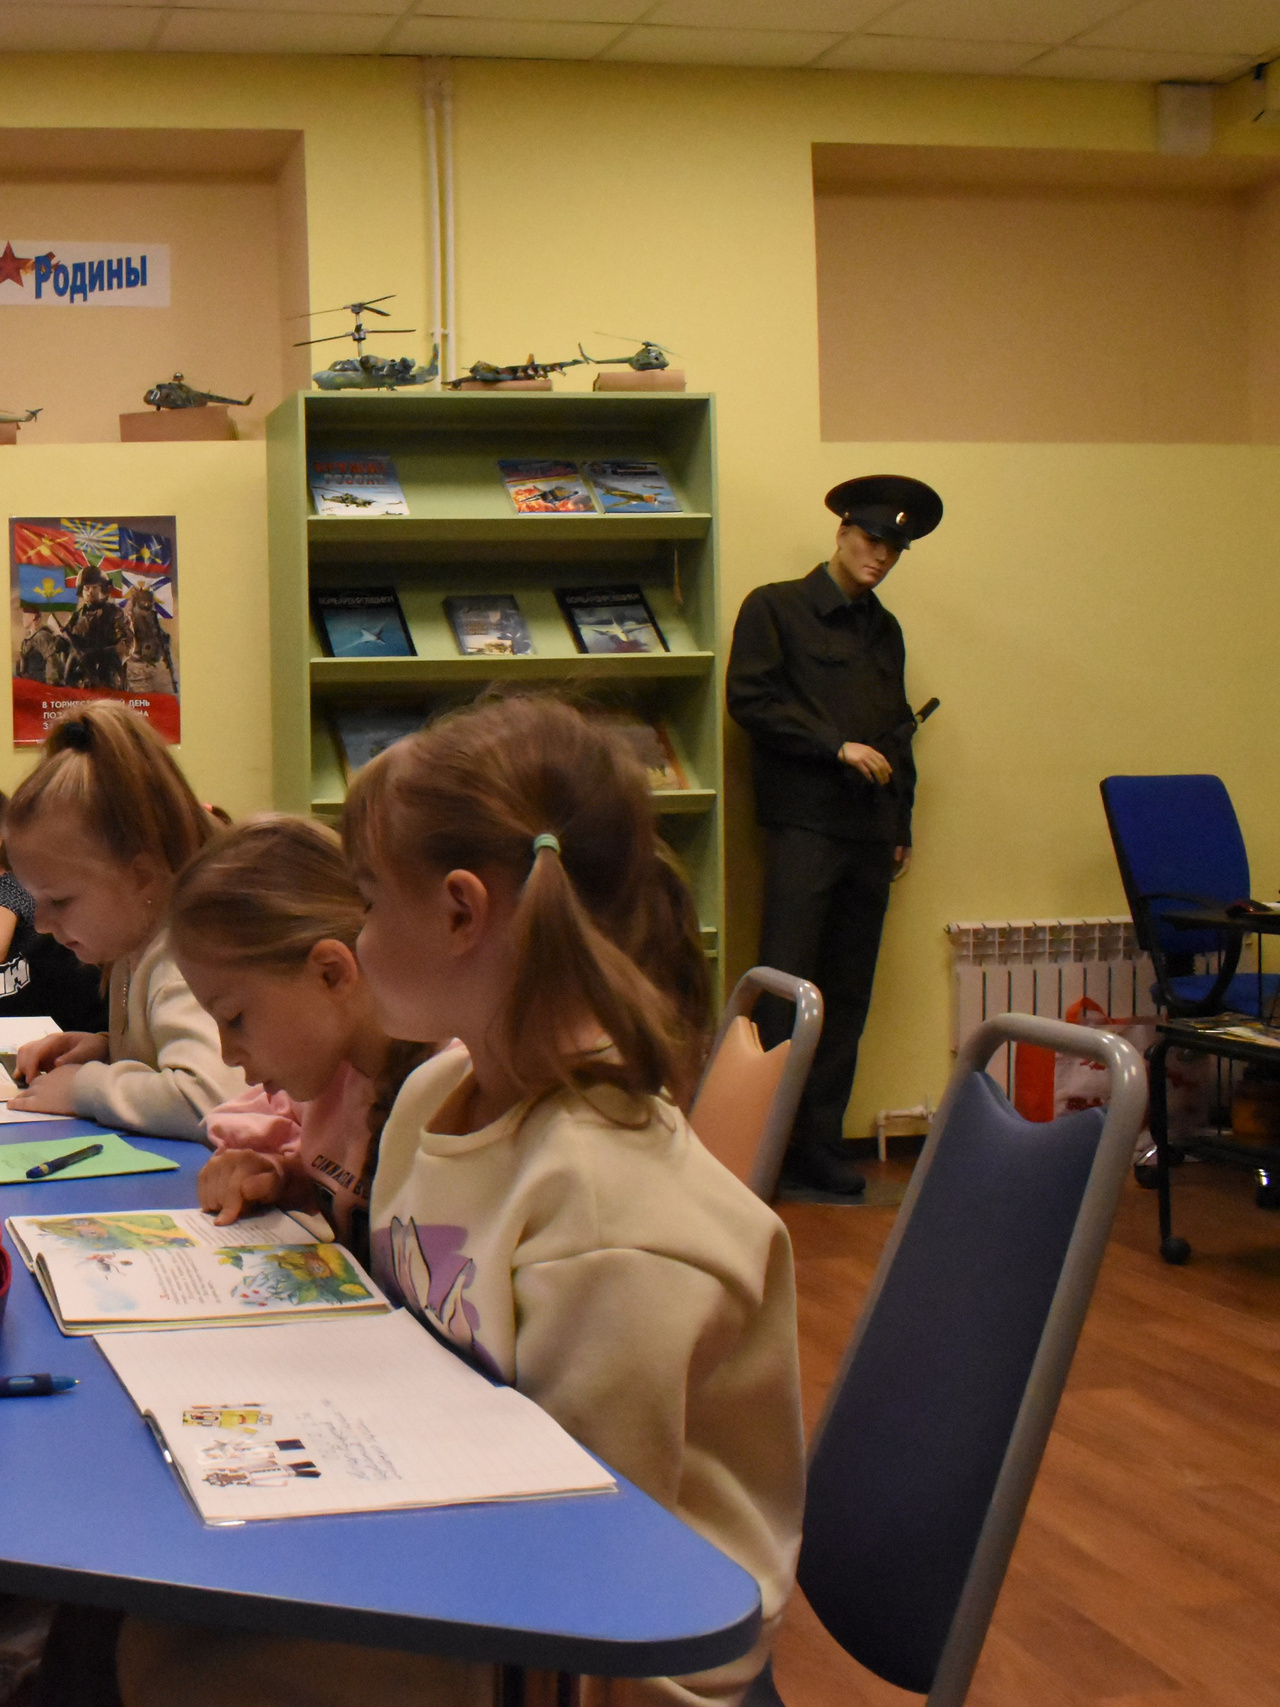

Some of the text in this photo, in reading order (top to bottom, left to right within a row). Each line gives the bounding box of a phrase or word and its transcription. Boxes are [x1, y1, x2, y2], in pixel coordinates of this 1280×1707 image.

[34, 255, 147, 304] Родины
[42, 701, 48, 709] В
[129, 699, 150, 708] ДЕНЬ
